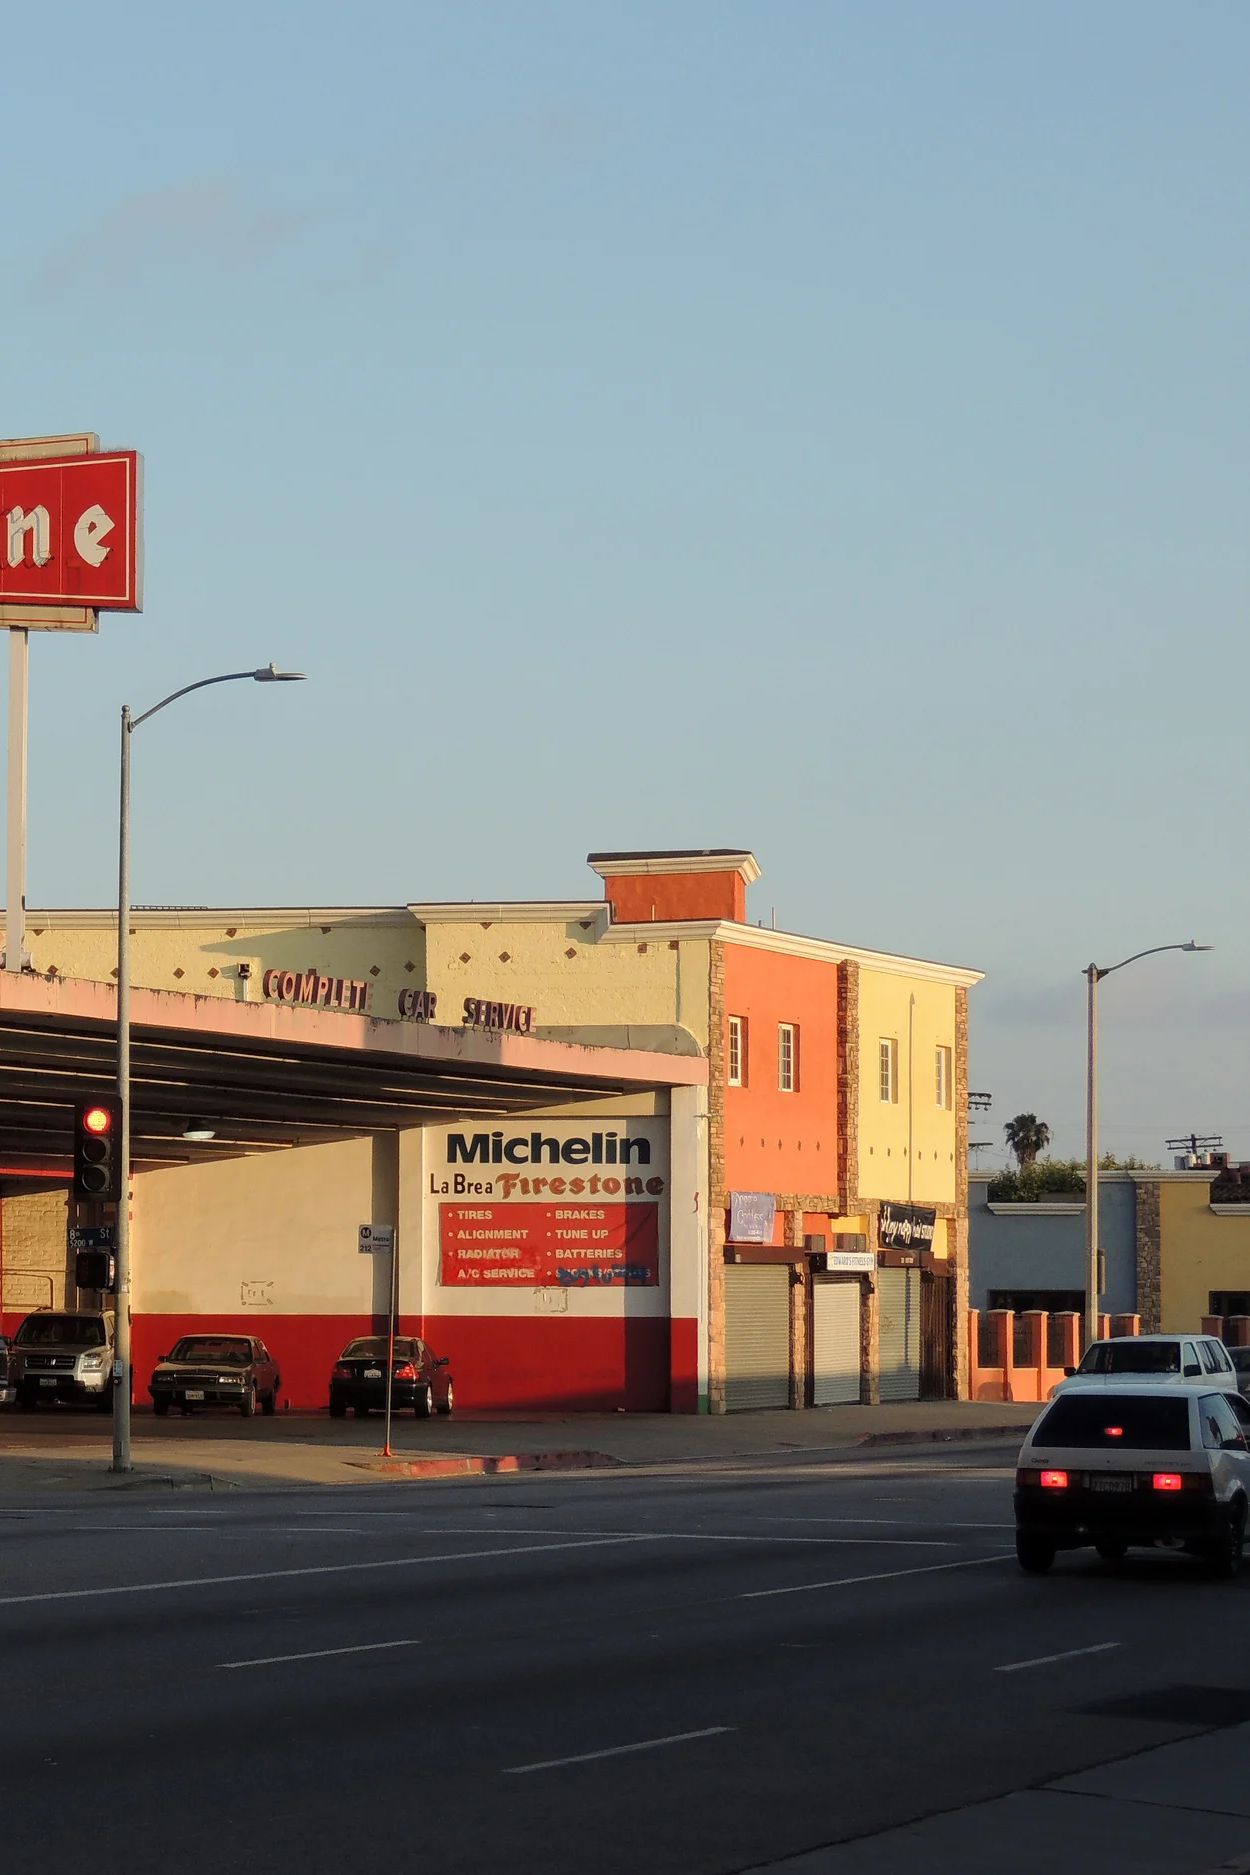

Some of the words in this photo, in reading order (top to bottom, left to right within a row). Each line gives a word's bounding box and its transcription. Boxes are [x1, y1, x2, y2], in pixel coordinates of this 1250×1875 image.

[264, 969, 375, 1012] COMPLETE
[399, 988, 437, 1019] CAR
[463, 997, 538, 1033] SERVICE
[447, 1131, 650, 1164] Michelin
[430, 1173, 449, 1194] La
[454, 1173, 493, 1194] Brea
[495, 1172, 665, 1199] Firestone
[457, 1210, 493, 1219] TIRES
[555, 1210, 605, 1219] BRAKES
[100, 1228, 110, 1239] St
[457, 1230, 528, 1239] ALIGNMENT
[555, 1230, 588, 1239] TUNE
[592, 1230, 608, 1239] UP
[70, 1239, 86, 1247] 5200
[457, 1249, 519, 1259] RADIATOR
[555, 1249, 623, 1259] BATTERIES
[457, 1268, 480, 1278] A/C
[483, 1268, 535, 1278] SERVICE
